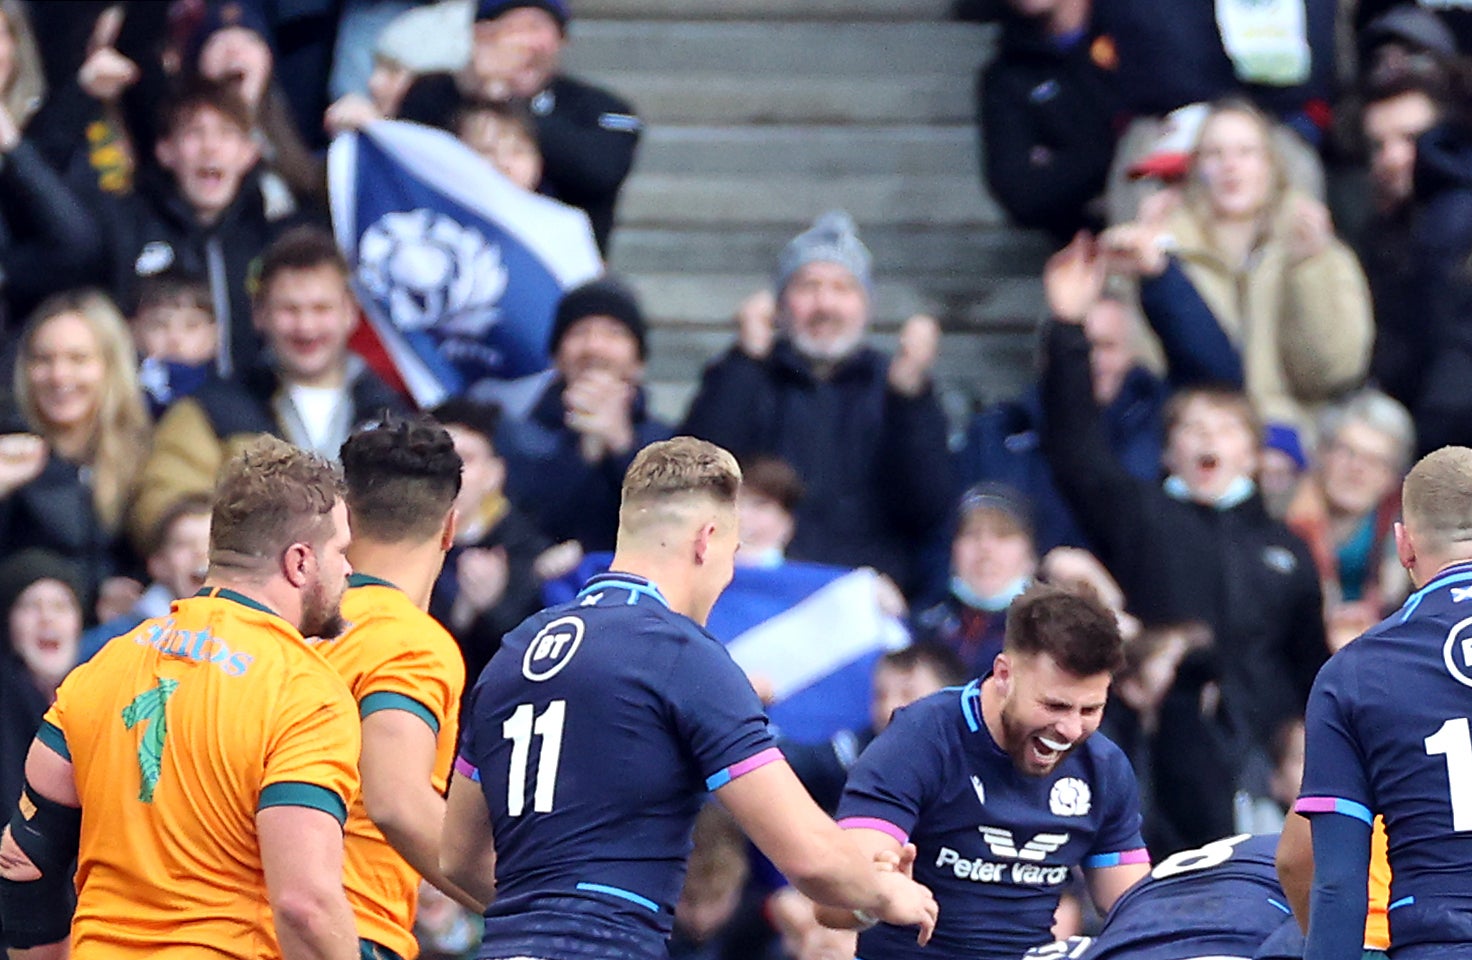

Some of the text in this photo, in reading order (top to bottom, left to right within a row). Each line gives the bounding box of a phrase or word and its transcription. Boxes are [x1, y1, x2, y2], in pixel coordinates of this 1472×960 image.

[532, 633, 571, 661] BT
[121, 677, 180, 804] 1
[503, 700, 566, 817] 11
[935, 846, 1007, 882] Peter
